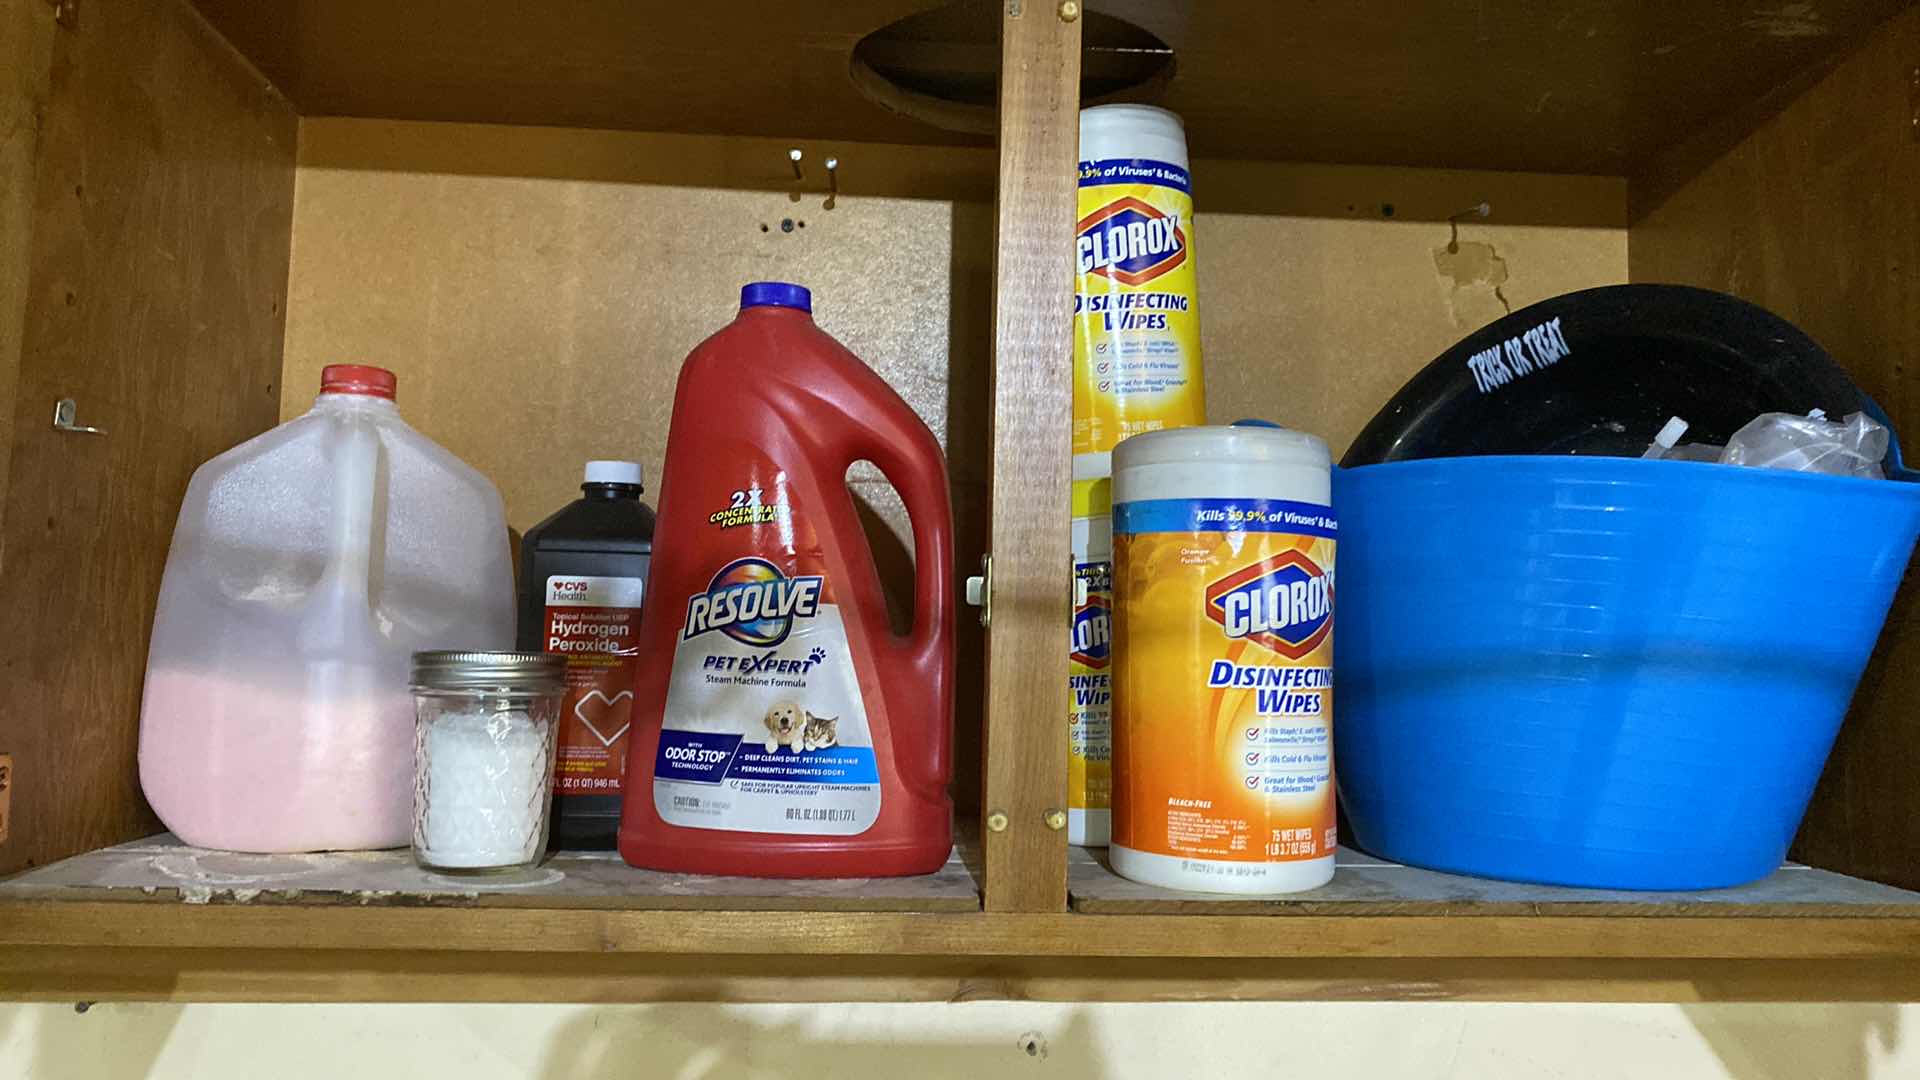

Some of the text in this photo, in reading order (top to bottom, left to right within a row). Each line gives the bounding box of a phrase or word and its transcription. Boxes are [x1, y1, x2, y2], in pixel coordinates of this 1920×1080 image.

[1104, 166, 1117, 177] of
[1157, 168, 1163, 178] &
[1077, 215, 1179, 274] CLOROX
[1104, 313, 1166, 330] WIPES
[1467, 316, 1571, 393] TRICK OR TREAT
[731, 489, 763, 508] 2X
[722, 514, 776, 528] FORMULA
[1196, 510, 1225, 521] Kills
[1227, 510, 1266, 522] 99.9%
[1269, 510, 1283, 522] of
[1318, 517, 1324, 527] &
[565, 582, 588, 591] CVS
[553, 591, 586, 601] Health
[1223, 567, 1334, 638] CLOROX
[687, 580, 819, 637] RESOLVE
[551, 620, 630, 638] Hydrogen
[1070, 612, 1110, 651] LOR
[549, 636, 620, 652] Peroxide
[703, 655, 738, 670] PET
[705, 675, 806, 687] Steam Machine Formula
[1258, 689, 1320, 713] WIPES
[665, 746, 697, 761] ODOR
[671, 761, 714, 771] TECHNOLOGY
[741, 765, 786, 774] PERMANENTLY
[786, 767, 822, 775] ELIMINATES
